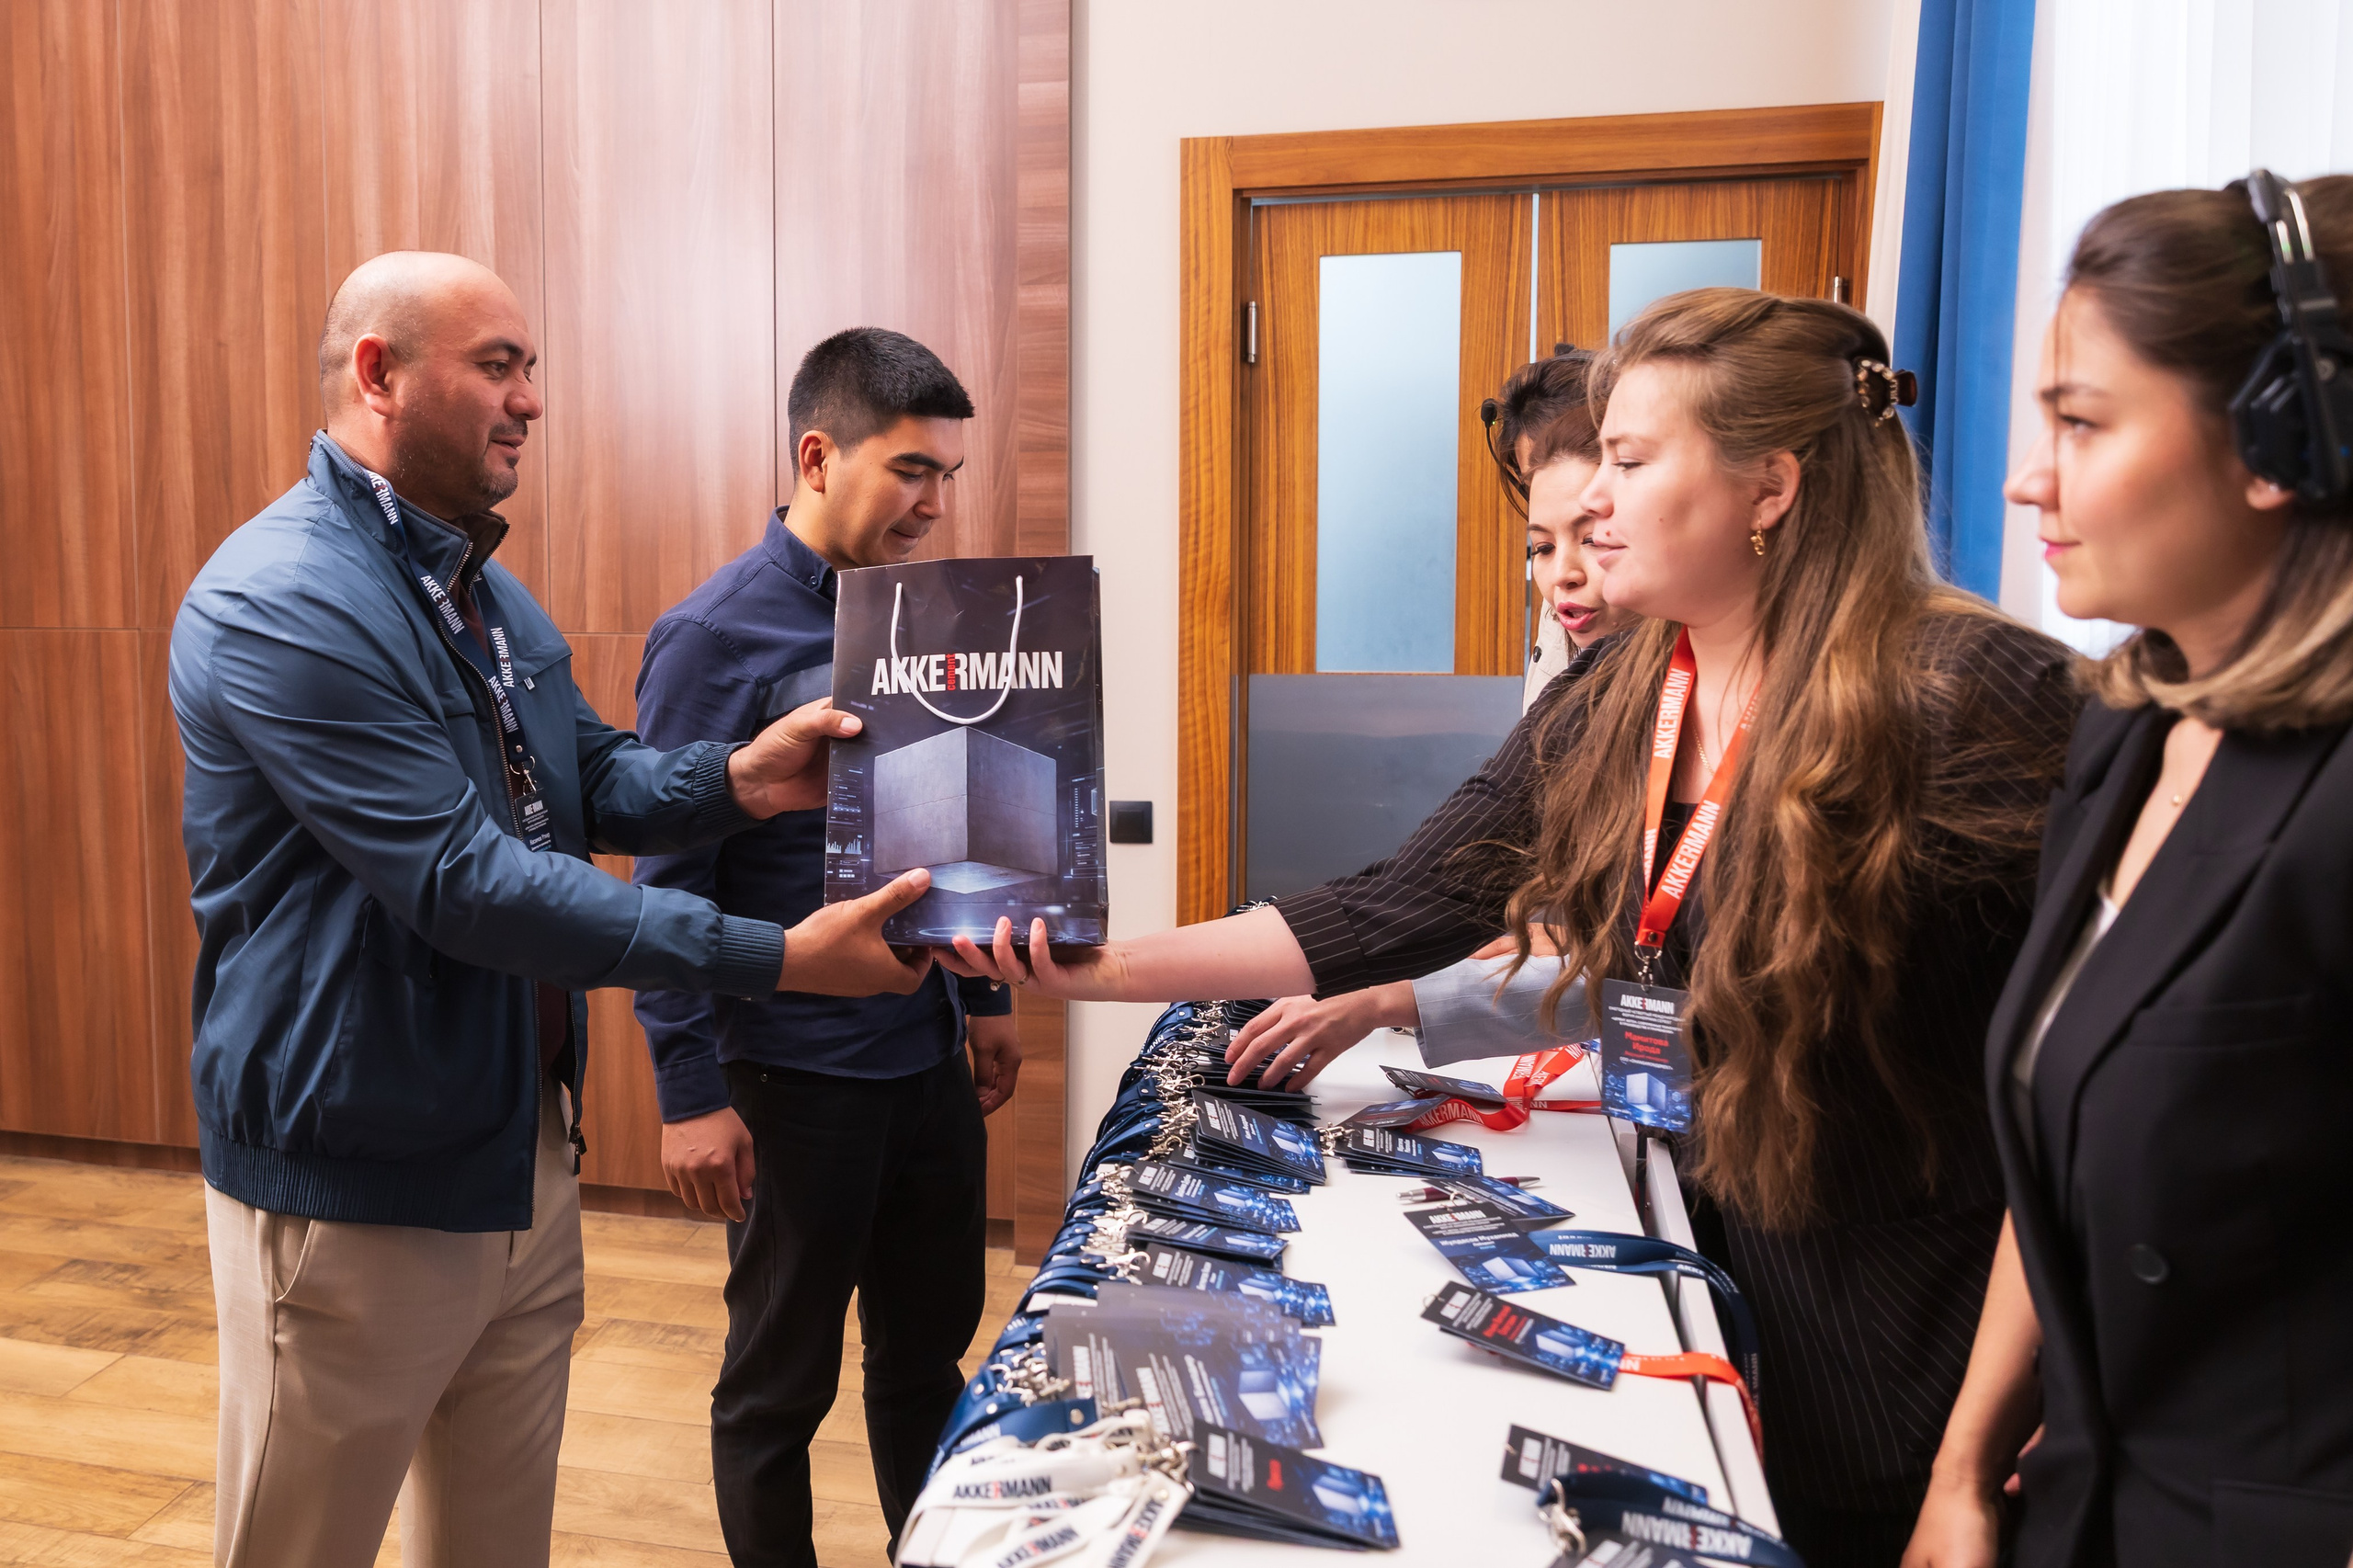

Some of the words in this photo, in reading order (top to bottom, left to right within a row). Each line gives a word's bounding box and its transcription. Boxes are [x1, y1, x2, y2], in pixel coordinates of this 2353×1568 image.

[420, 574, 465, 635] AKKERMANN
[490, 627, 515, 687] AKKERMANN
[871, 651, 1063, 696] AKKERMANN
[946, 653, 956, 691] cement
[488, 675, 519, 733] AKKERMANN
[1654, 668, 1690, 759] AKKERMANN
[1660, 799, 1722, 901] AKKERMANN
[1620, 994, 1675, 1015] AKKERMANN
[1418, 1102, 1484, 1129] AKKERMANN
[1549, 1244, 1617, 1258] AKKERMANN
[953, 1474, 1052, 1501] AKKERMANN
